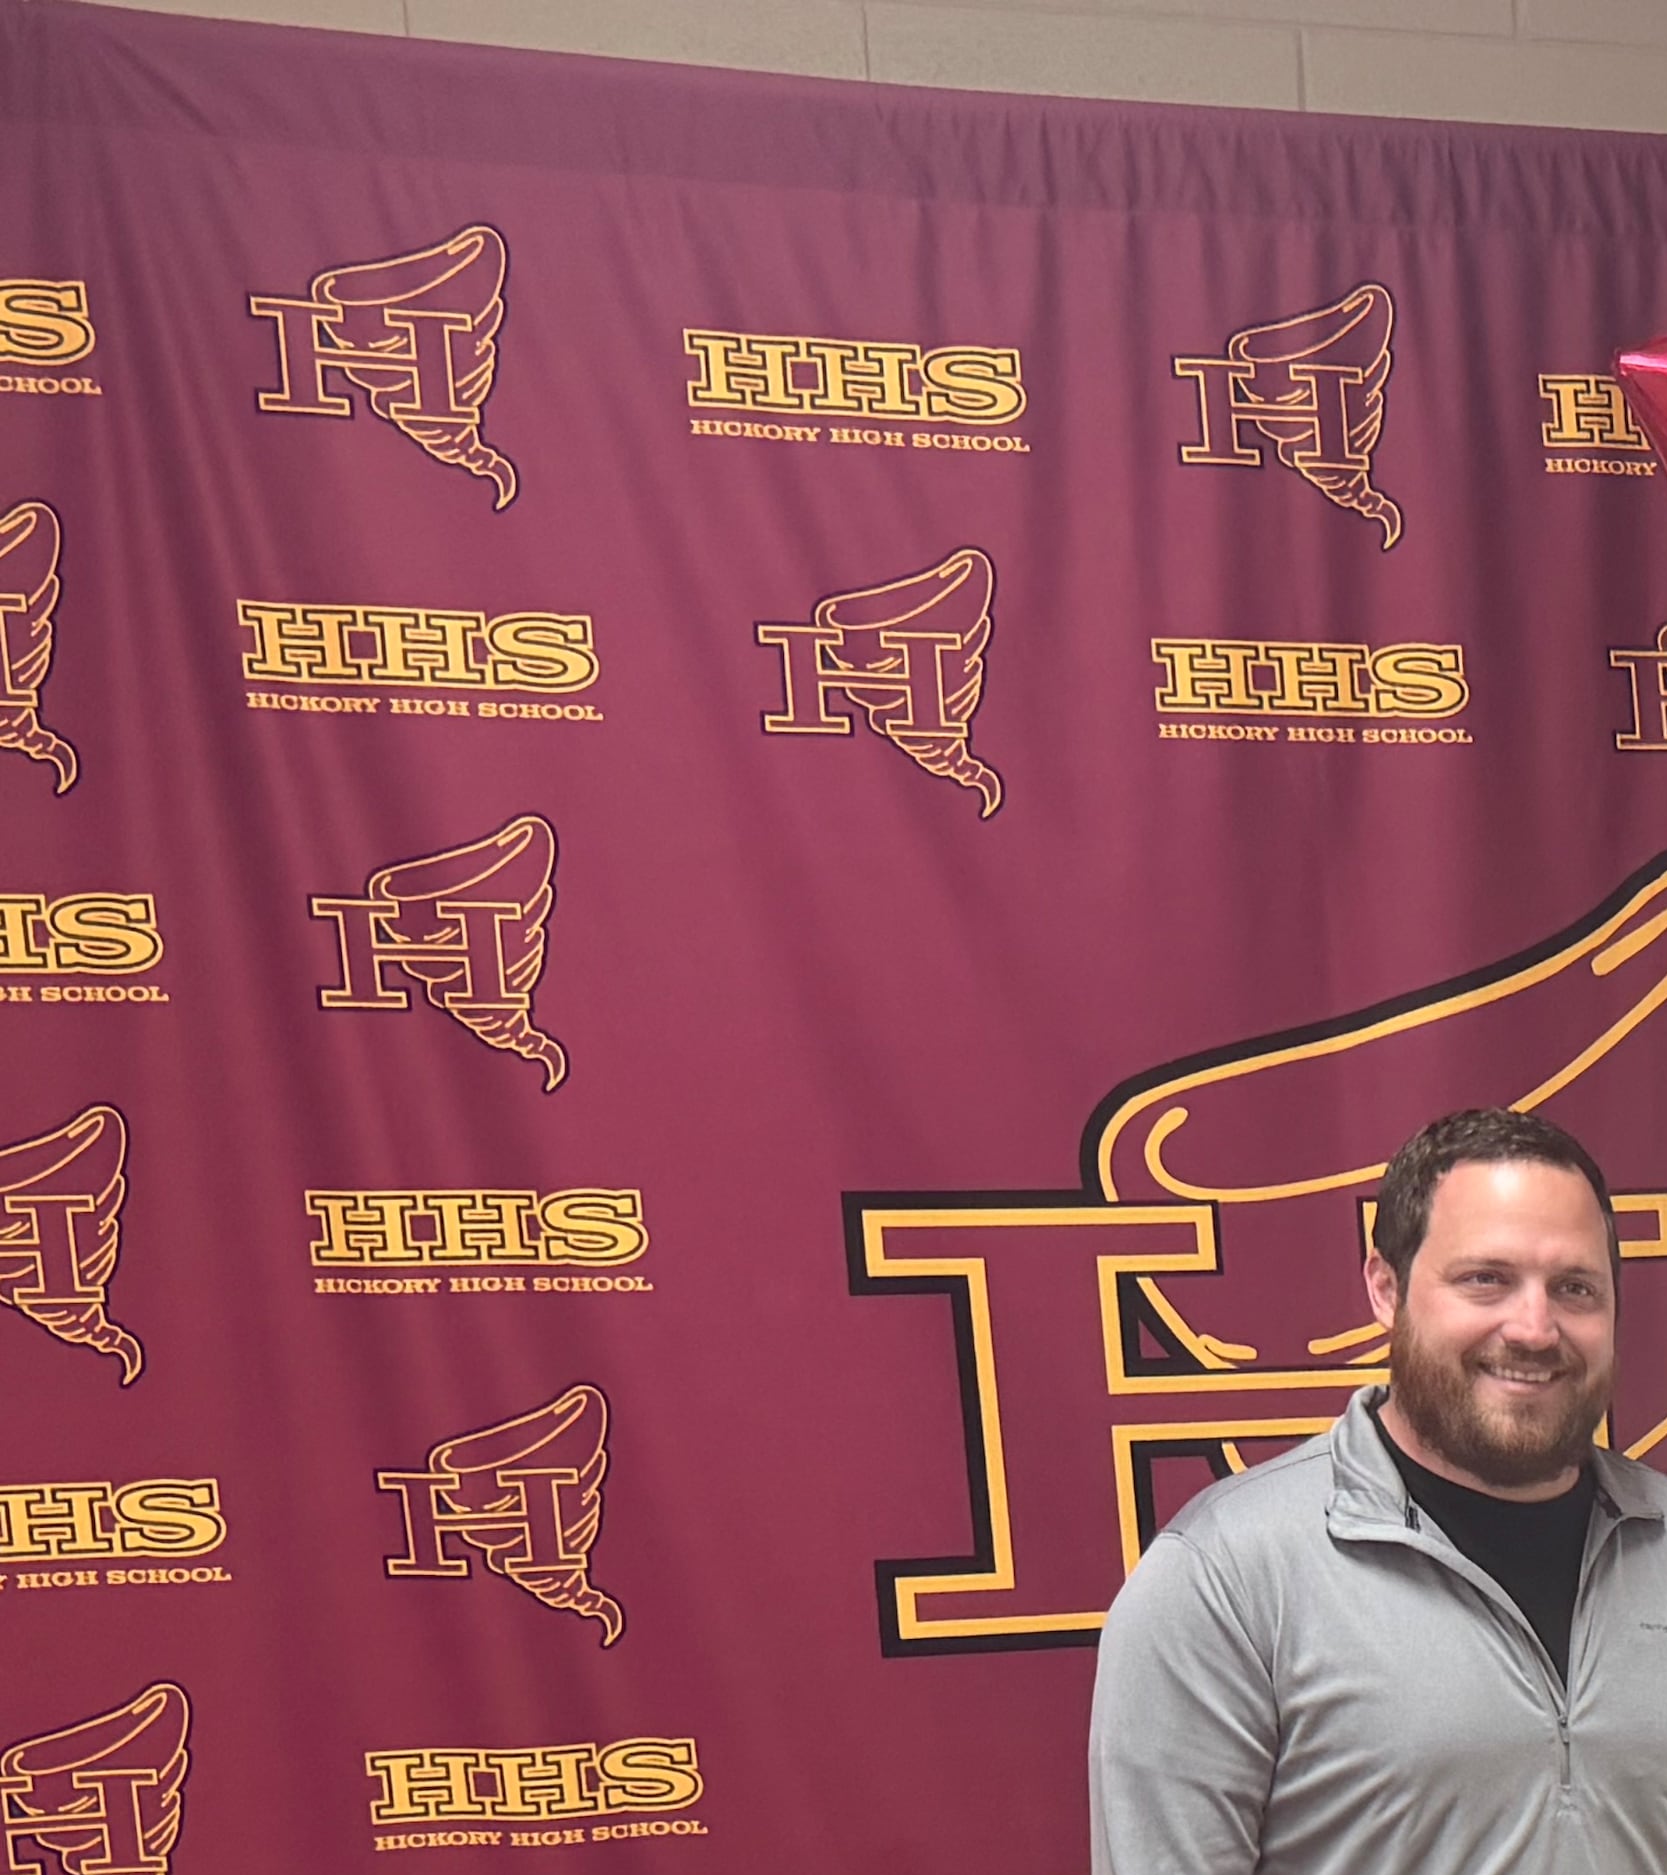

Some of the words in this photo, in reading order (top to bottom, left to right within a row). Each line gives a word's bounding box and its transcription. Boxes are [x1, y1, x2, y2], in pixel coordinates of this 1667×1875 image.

[683, 328, 1027, 425] HHS
[690, 419, 821, 443] HICKORY
[830, 426, 905, 448] HIGH
[913, 432, 1031, 454] SCHOOL
[1545, 457, 1657, 476] HICKORY
[237, 599, 600, 693] HHS
[1151, 639, 1470, 721] HHS
[246, 692, 381, 716] HICKORY
[389, 697, 471, 718] HIGH
[478, 702, 604, 722] SCHOOL
[1158, 724, 1280, 742] HICKORY
[1287, 726, 1356, 744] HIGH
[1363, 727, 1474, 745] SCHOOL
[40, 985, 170, 1002] SCHOOL
[304, 1190, 649, 1267] HHS
[314, 1278, 441, 1294] HICKORY
[450, 1277, 526, 1293] HIGH
[533, 1276, 654, 1293] SCHOOL
[0, 1478, 227, 1562] HS
[17, 1570, 98, 1589] HIGH
[105, 1565, 232, 1585] SCHOOL
[365, 1737, 704, 1825] HHS
[375, 1829, 503, 1852] HICKORY
[511, 1825, 585, 1848] HIGH
[592, 1820, 709, 1841] SCHOOL
